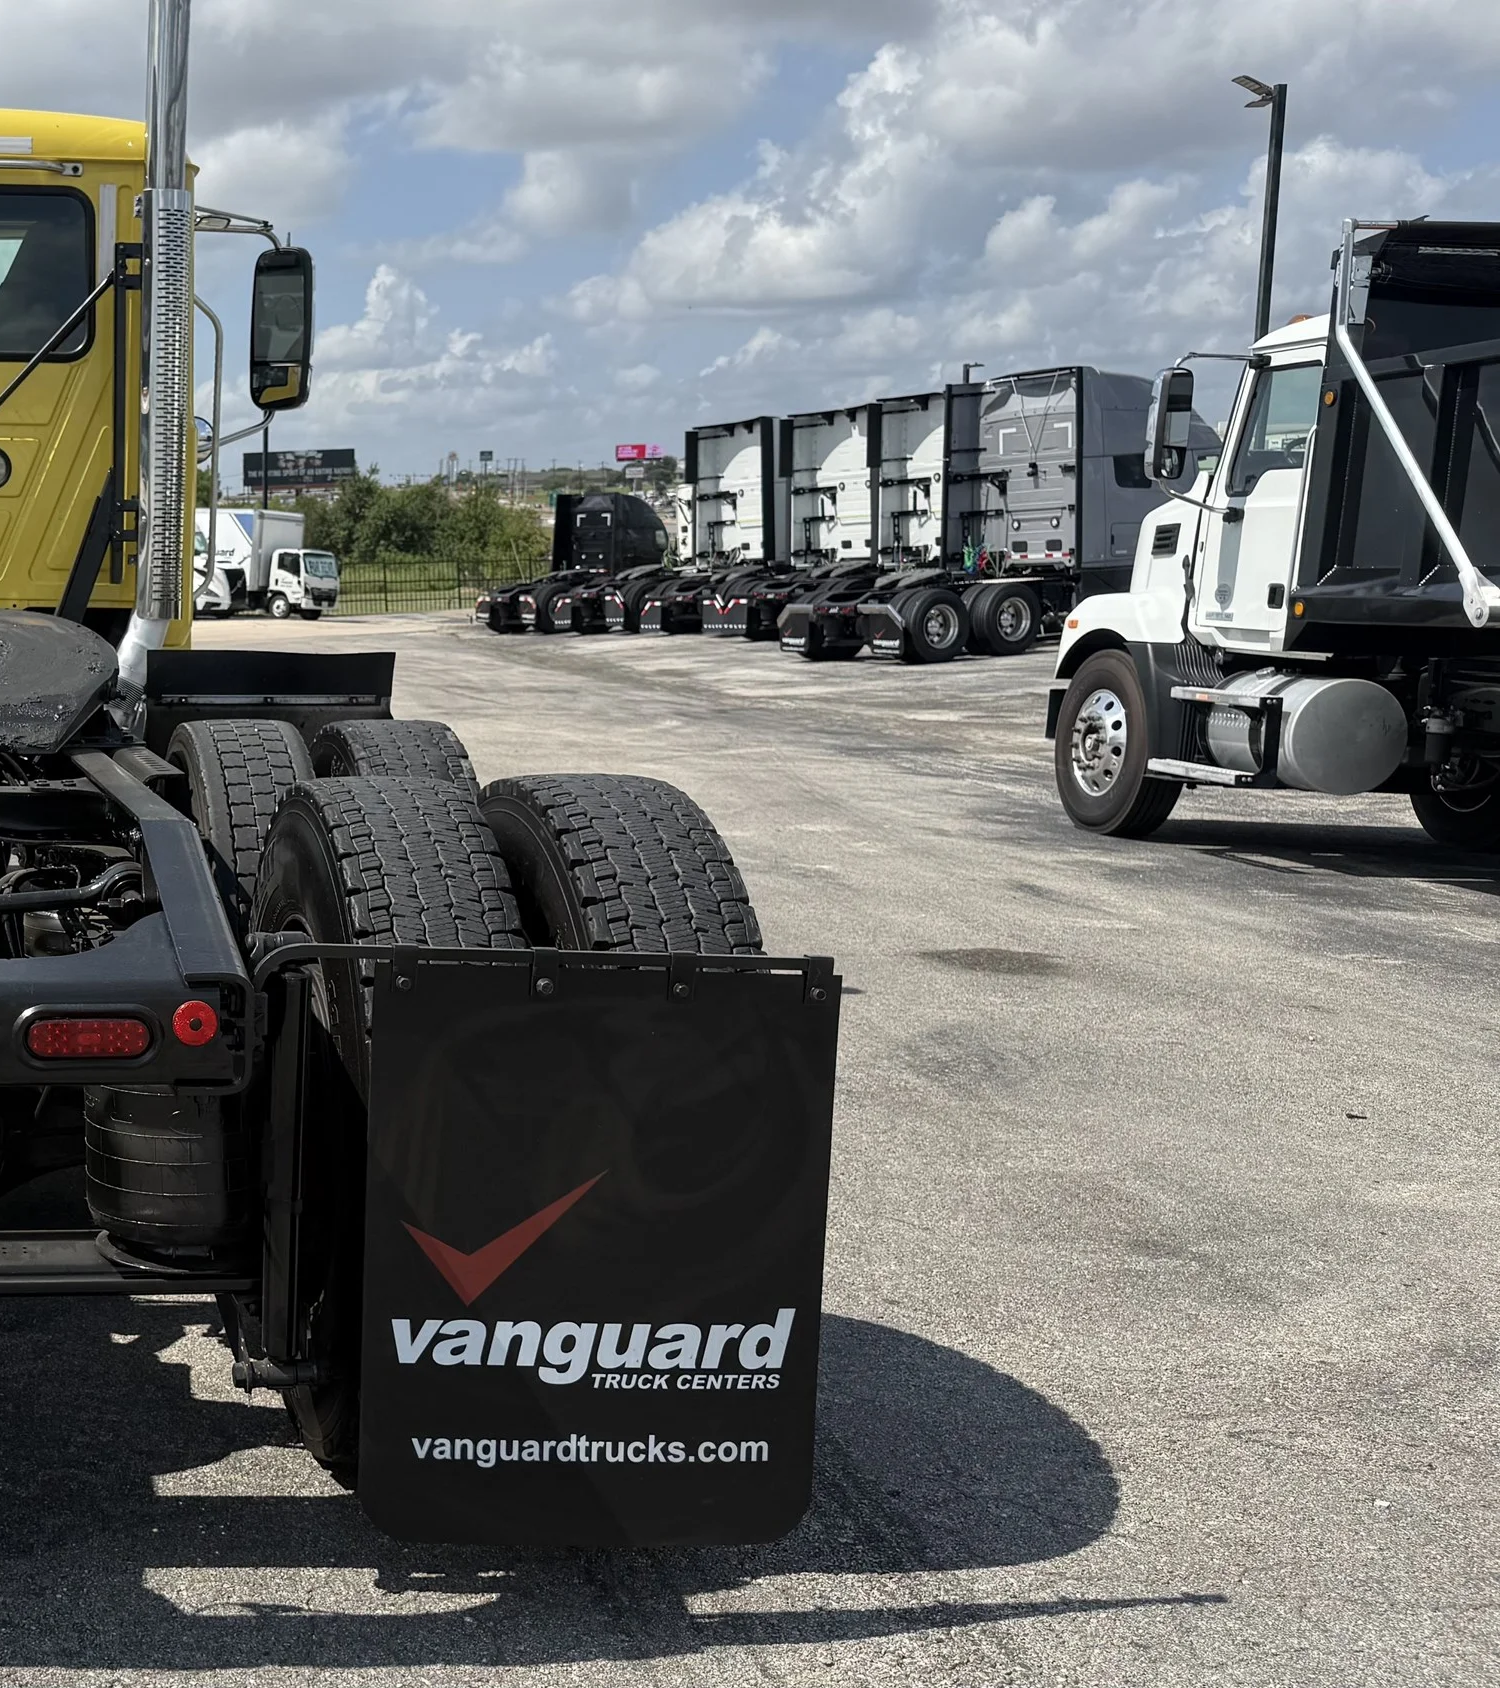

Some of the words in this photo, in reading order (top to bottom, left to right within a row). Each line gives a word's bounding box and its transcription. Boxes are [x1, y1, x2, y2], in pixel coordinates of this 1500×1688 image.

[391, 1308, 796, 1385] vanguard
[591, 1373, 669, 1390] TRUCK
[676, 1373, 781, 1390] CENTERS
[411, 1433, 769, 1468] vanguardtrucks.com
